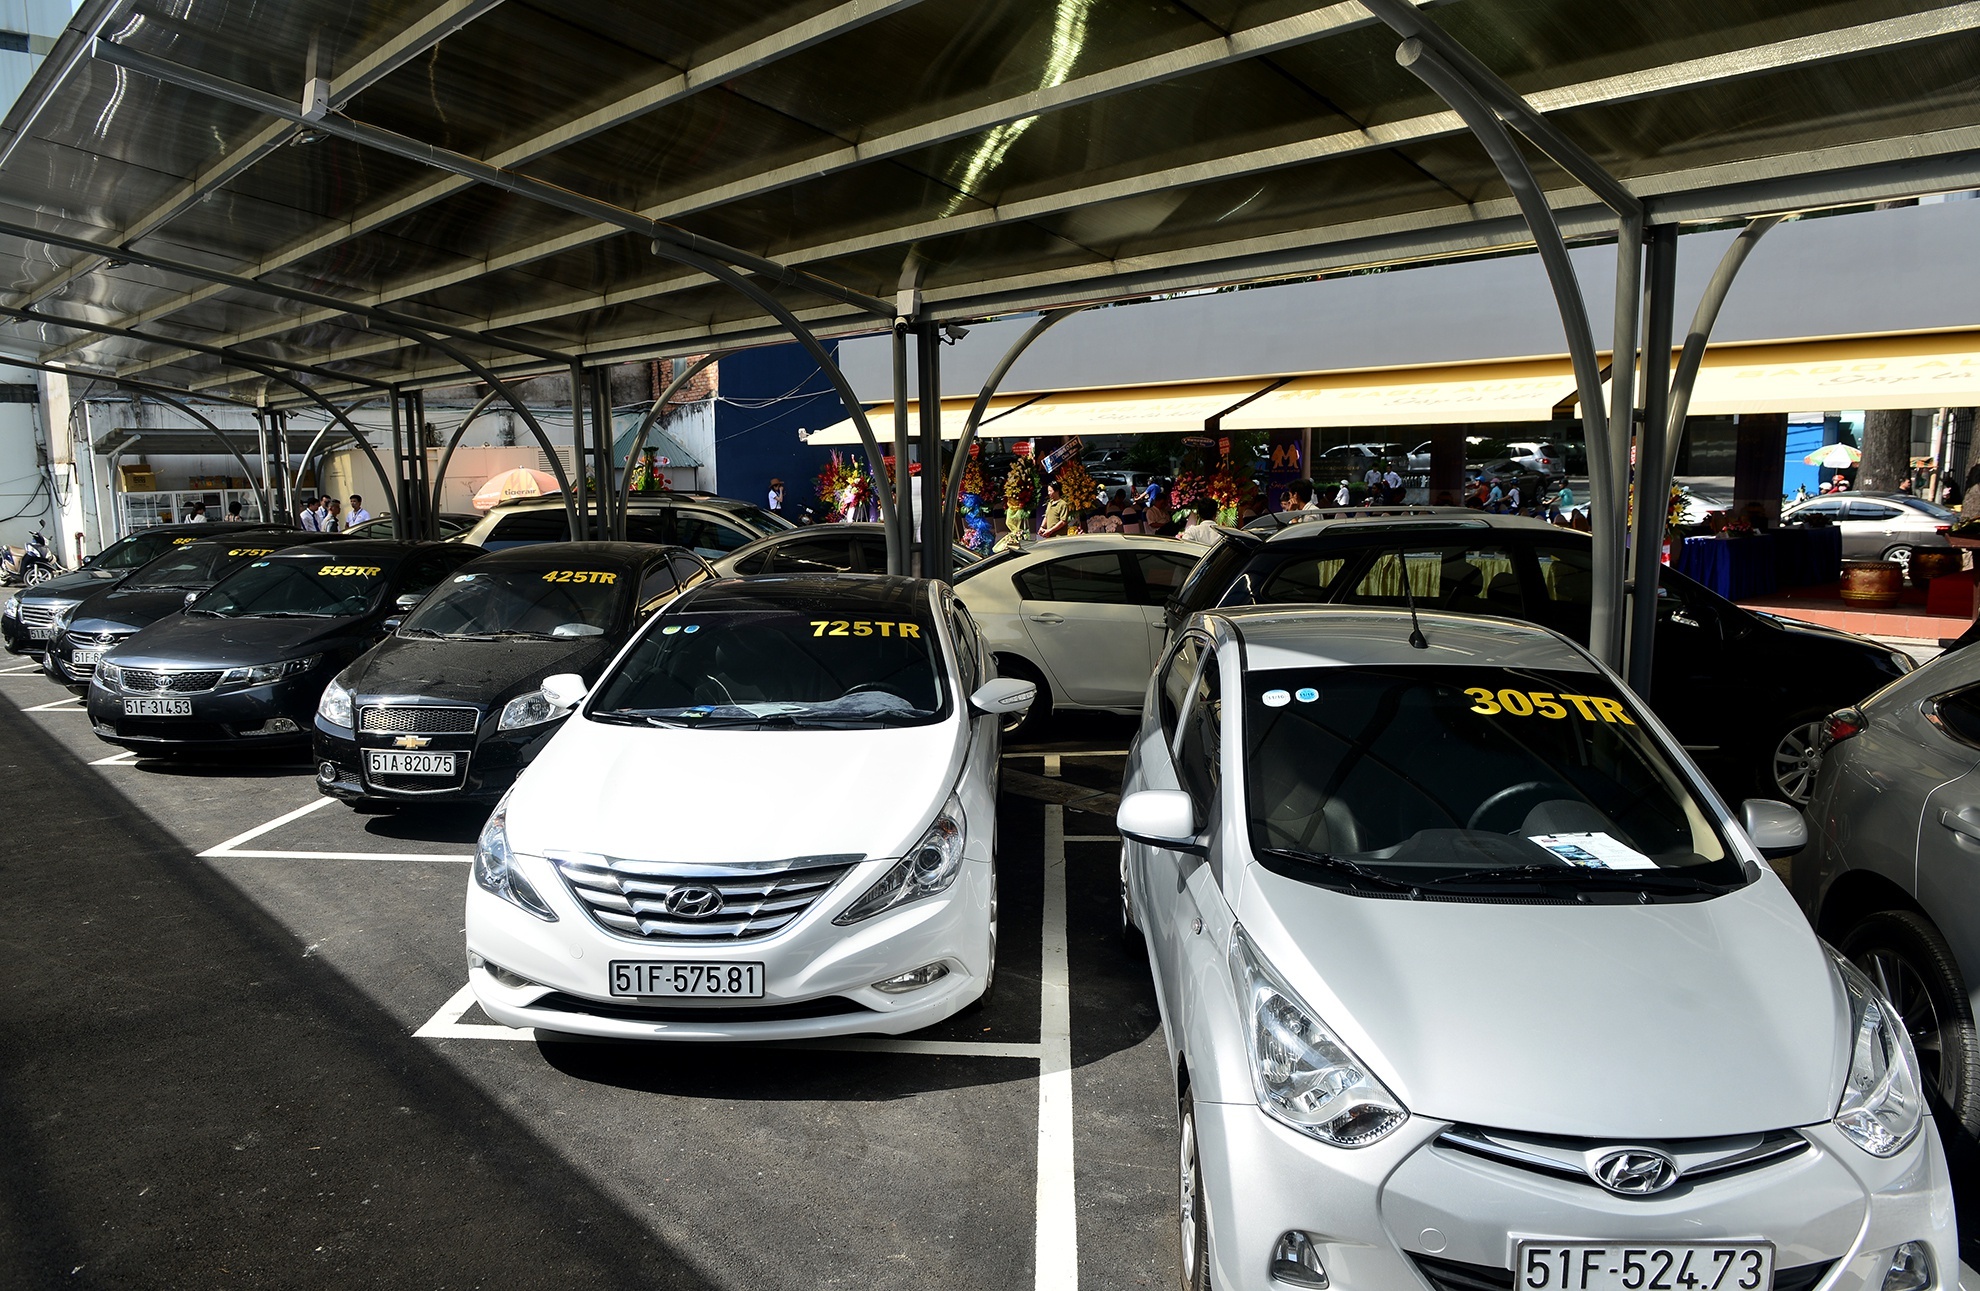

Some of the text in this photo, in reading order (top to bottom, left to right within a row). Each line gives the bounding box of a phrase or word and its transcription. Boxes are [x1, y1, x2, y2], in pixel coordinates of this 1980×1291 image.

[228, 549, 275, 557] 675T
[318, 566, 381, 577] 555TR
[542, 571, 617, 584] 425TR
[810, 621, 921, 638] 725TR
[125, 700, 190, 714] 51F-314.53
[1464, 687, 1636, 726] 305TR
[372, 755, 452, 772] 51A-820.75
[616, 965, 754, 993] 51F-575.81
[1526, 1249, 1763, 1291] 51F-524.73
